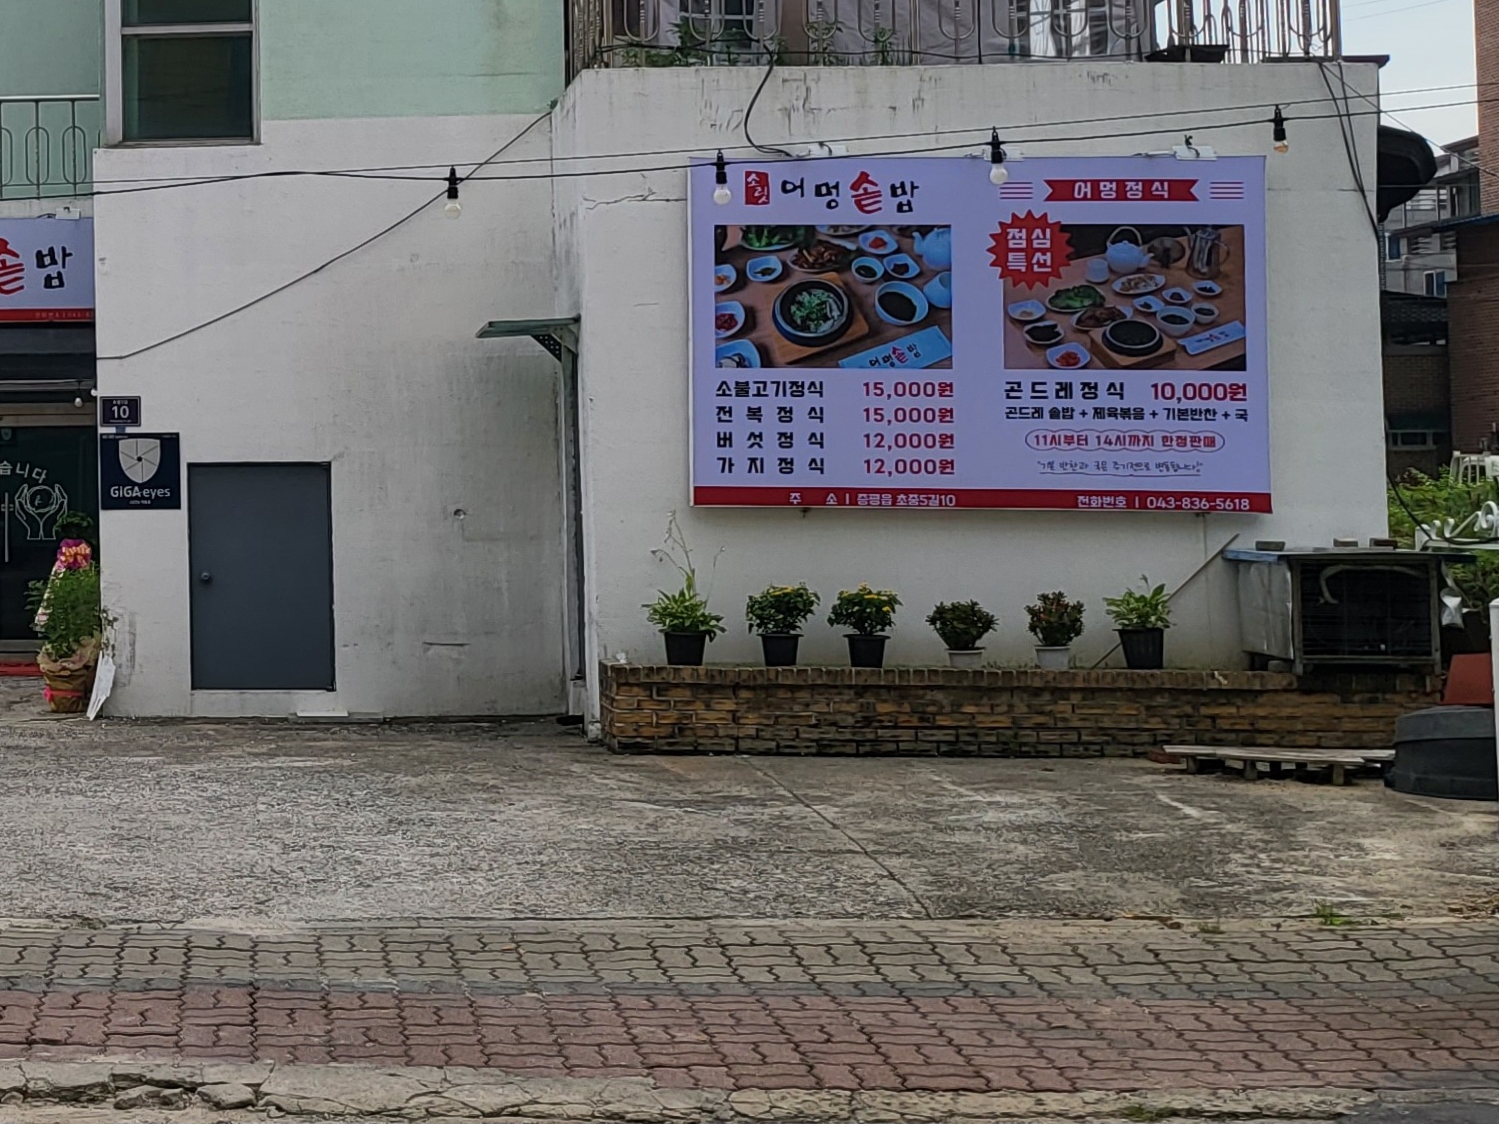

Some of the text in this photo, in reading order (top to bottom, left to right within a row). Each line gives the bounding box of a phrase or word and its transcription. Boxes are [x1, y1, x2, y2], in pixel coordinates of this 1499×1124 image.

[780, 171, 920, 215] 어멍솥밥
[1006, 228, 1051, 249] 점심
[1007, 252, 1052, 272] 특선
[715, 380, 954, 400] 소불고기정식 15,000원
[1150, 382, 1248, 404] 10,000원
[112, 405, 130, 419] 10
[862, 407, 954, 426] 15,000원
[1004, 406, 1044, 420] 곤드레
[1092, 406, 1146, 421] 제육볶음
[1163, 407, 1217, 422] 기본반찬
[1234, 409, 1249, 422] 국
[863, 432, 955, 452] 12,000원
[1033, 434, 1217, 449] 11시부터 14시까지 한정판매
[863, 458, 956, 477] 12,000원
[857, 493, 893, 506] 증평읍
[896, 493, 957, 507] 초중5길10
[1077, 495, 1251, 511] 전화번호 043-836-5618
